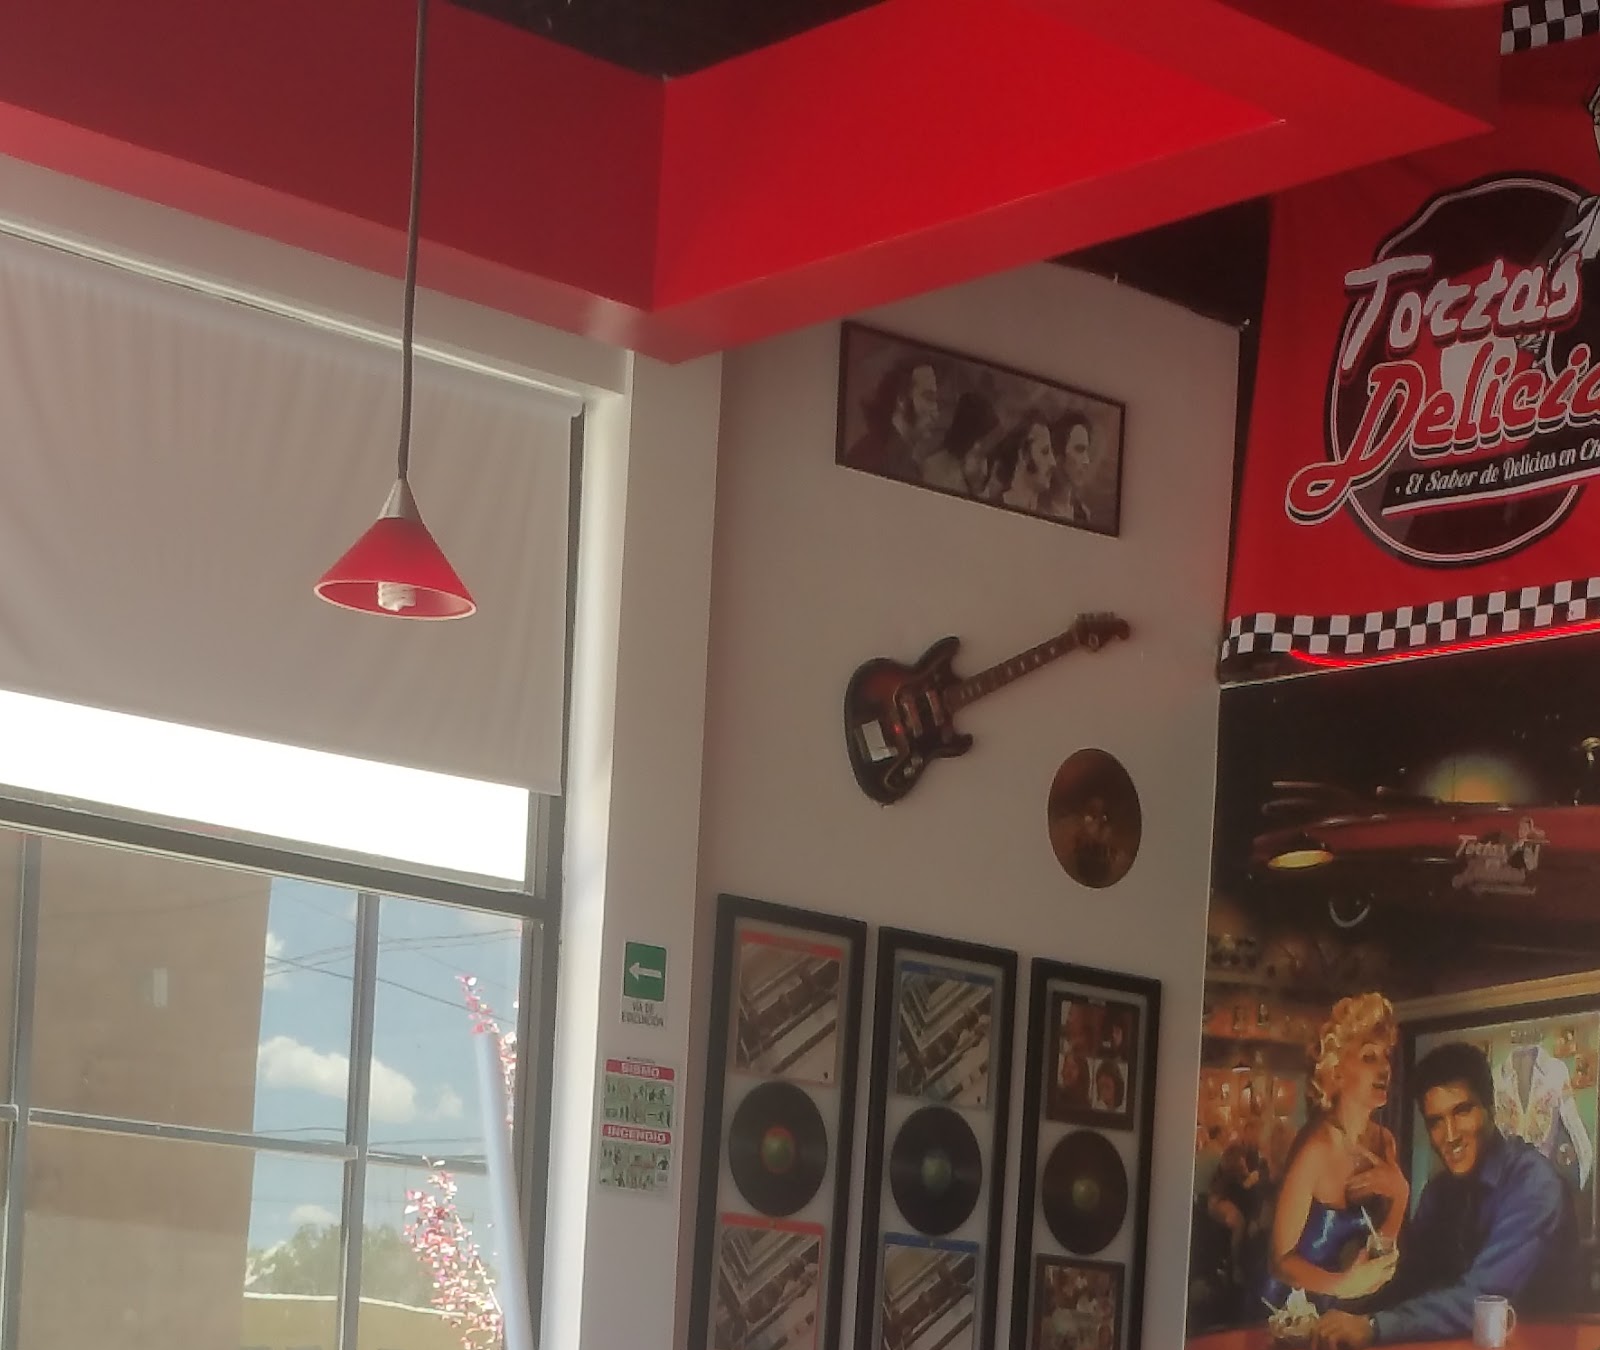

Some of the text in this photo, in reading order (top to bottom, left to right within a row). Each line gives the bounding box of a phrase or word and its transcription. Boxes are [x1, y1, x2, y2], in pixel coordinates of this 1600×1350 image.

[1344, 250, 1583, 373] Tortas
[1405, 473, 1422, 495] El
[1425, 467, 1478, 493] Sabor
[1479, 464, 1499, 484] de
[1502, 454, 1557, 481] Delicias
[1558, 448, 1576, 467] en
